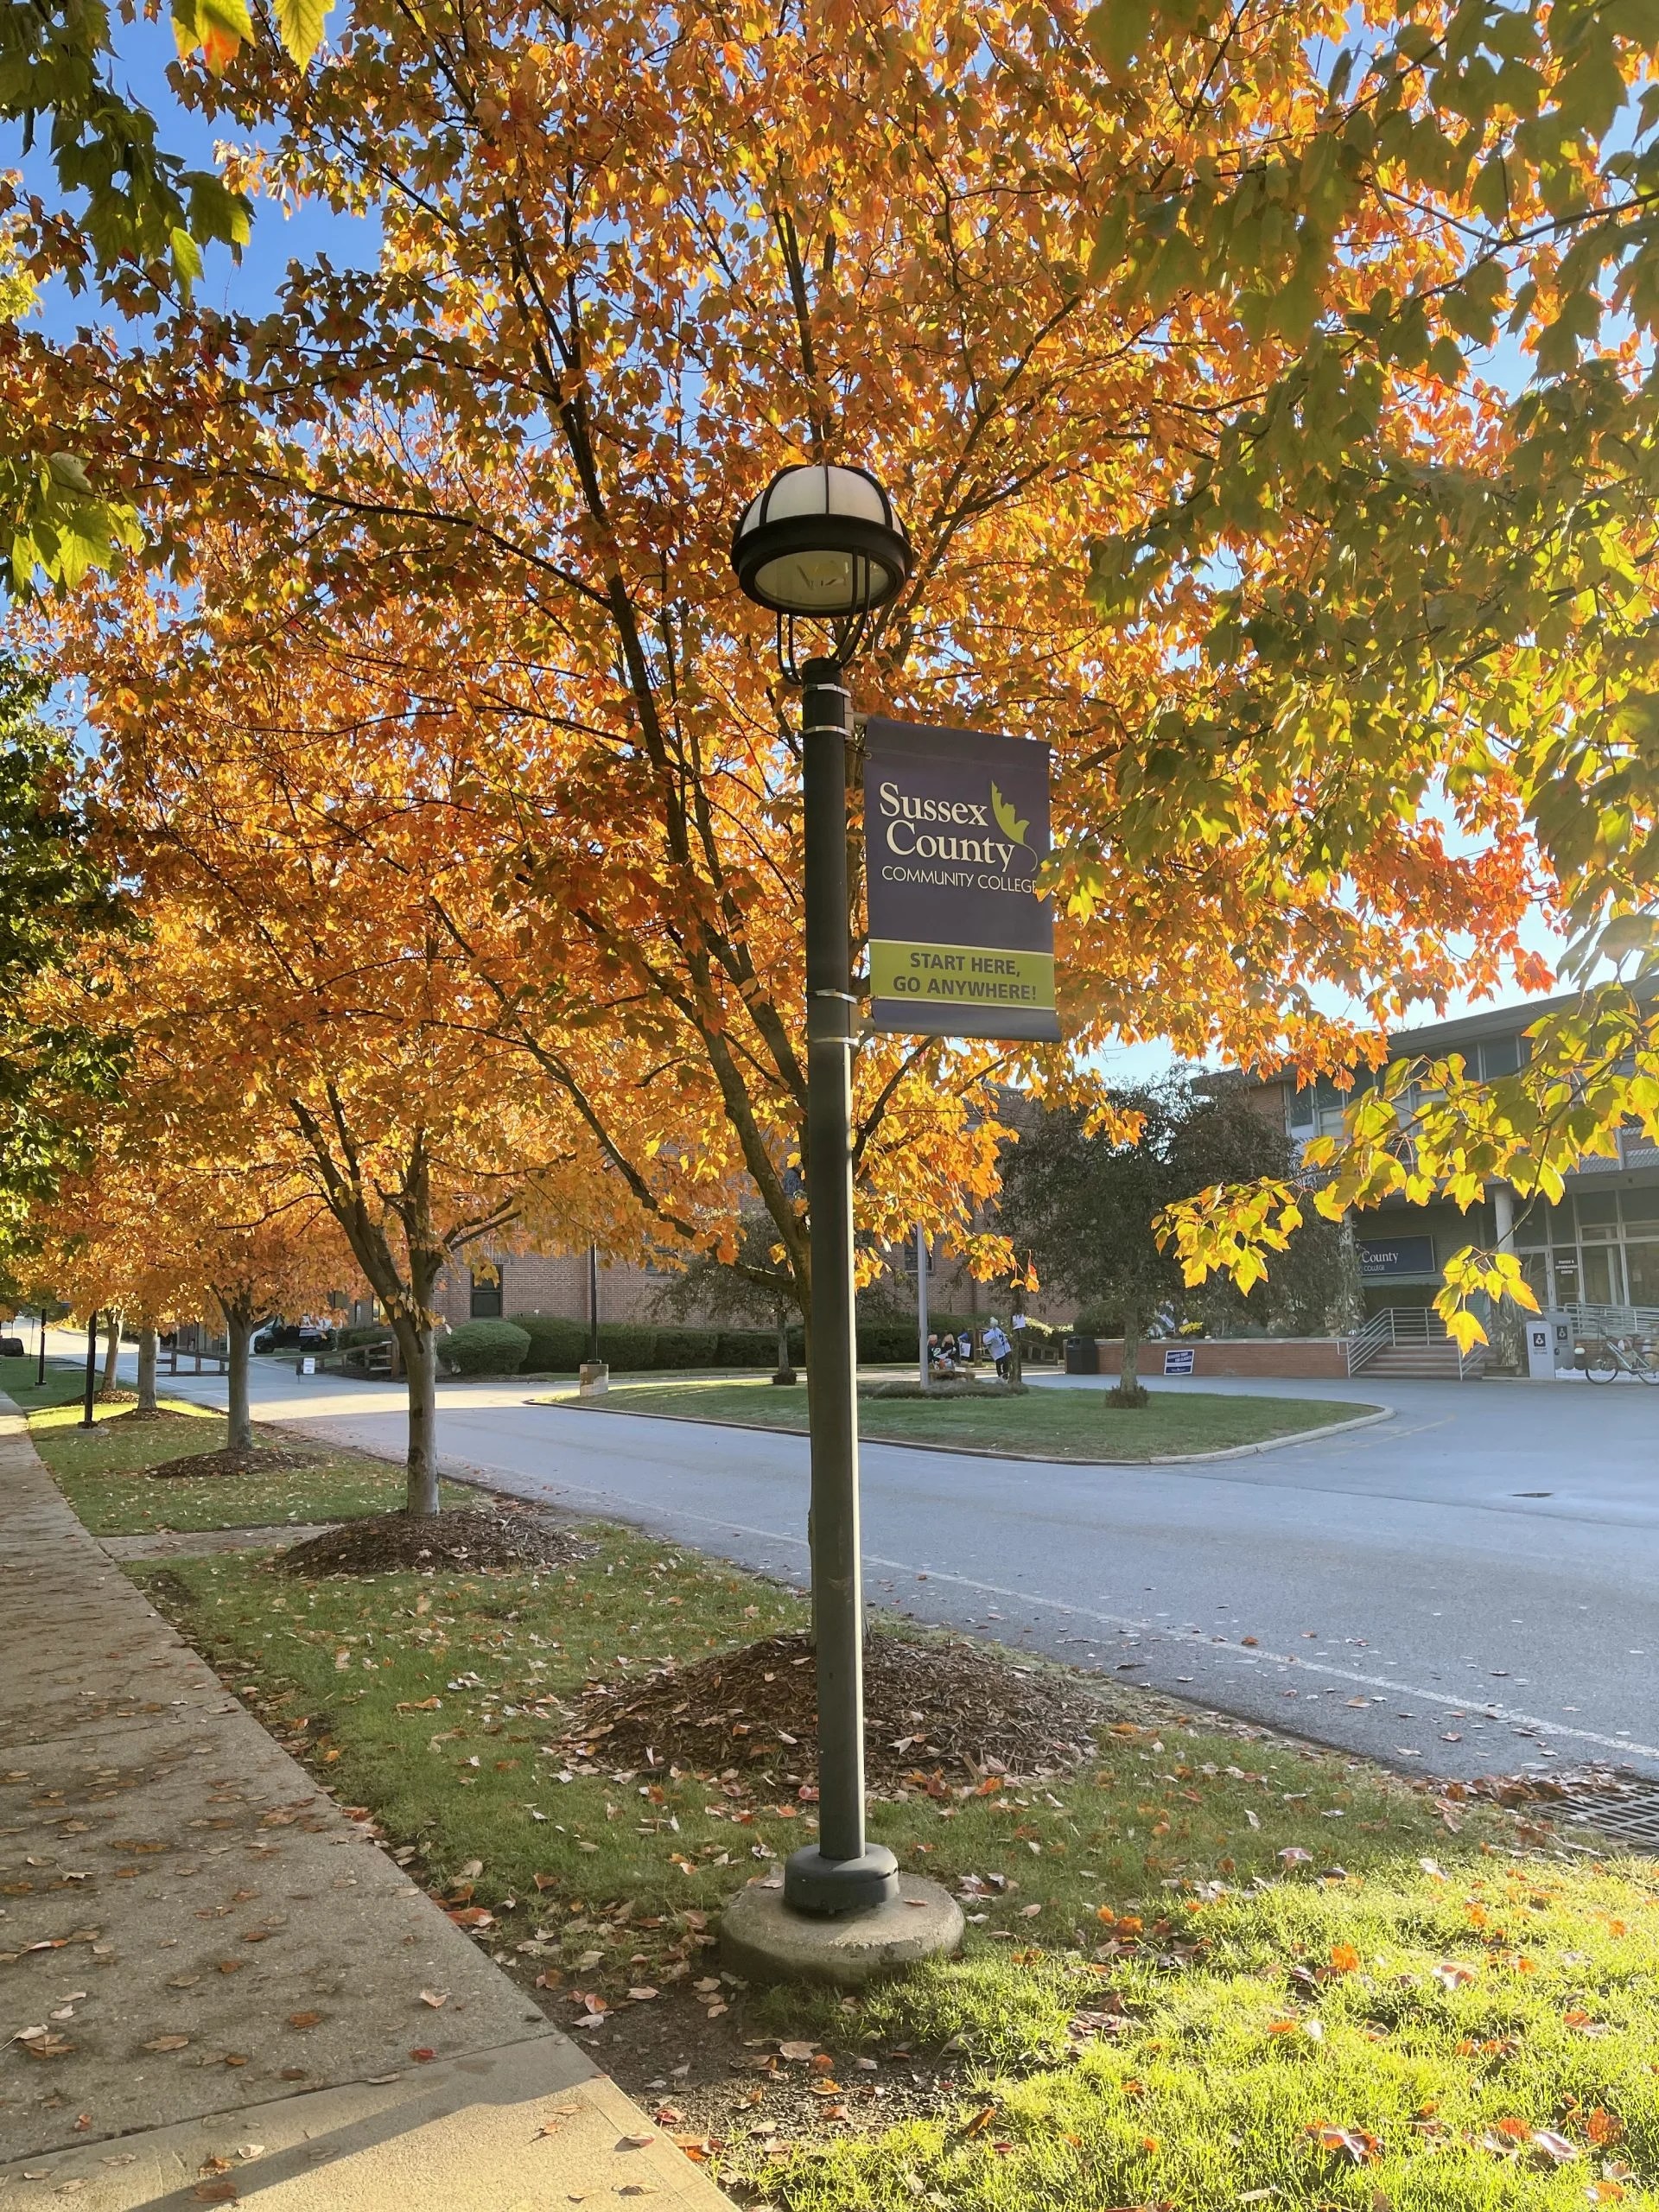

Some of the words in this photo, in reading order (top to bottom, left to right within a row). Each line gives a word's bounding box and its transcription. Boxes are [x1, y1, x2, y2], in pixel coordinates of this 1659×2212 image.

[880, 781, 989, 827] Sussex
[886, 819, 1016, 873] County
[881, 865, 975, 887] COMMUNITY
[910, 952, 965, 971] START
[971, 957, 1020, 977] HERE,
[893, 976, 920, 993] GO
[926, 978, 1036, 1001] ANYWHERE!
[1362, 1250, 1399, 1264] County
